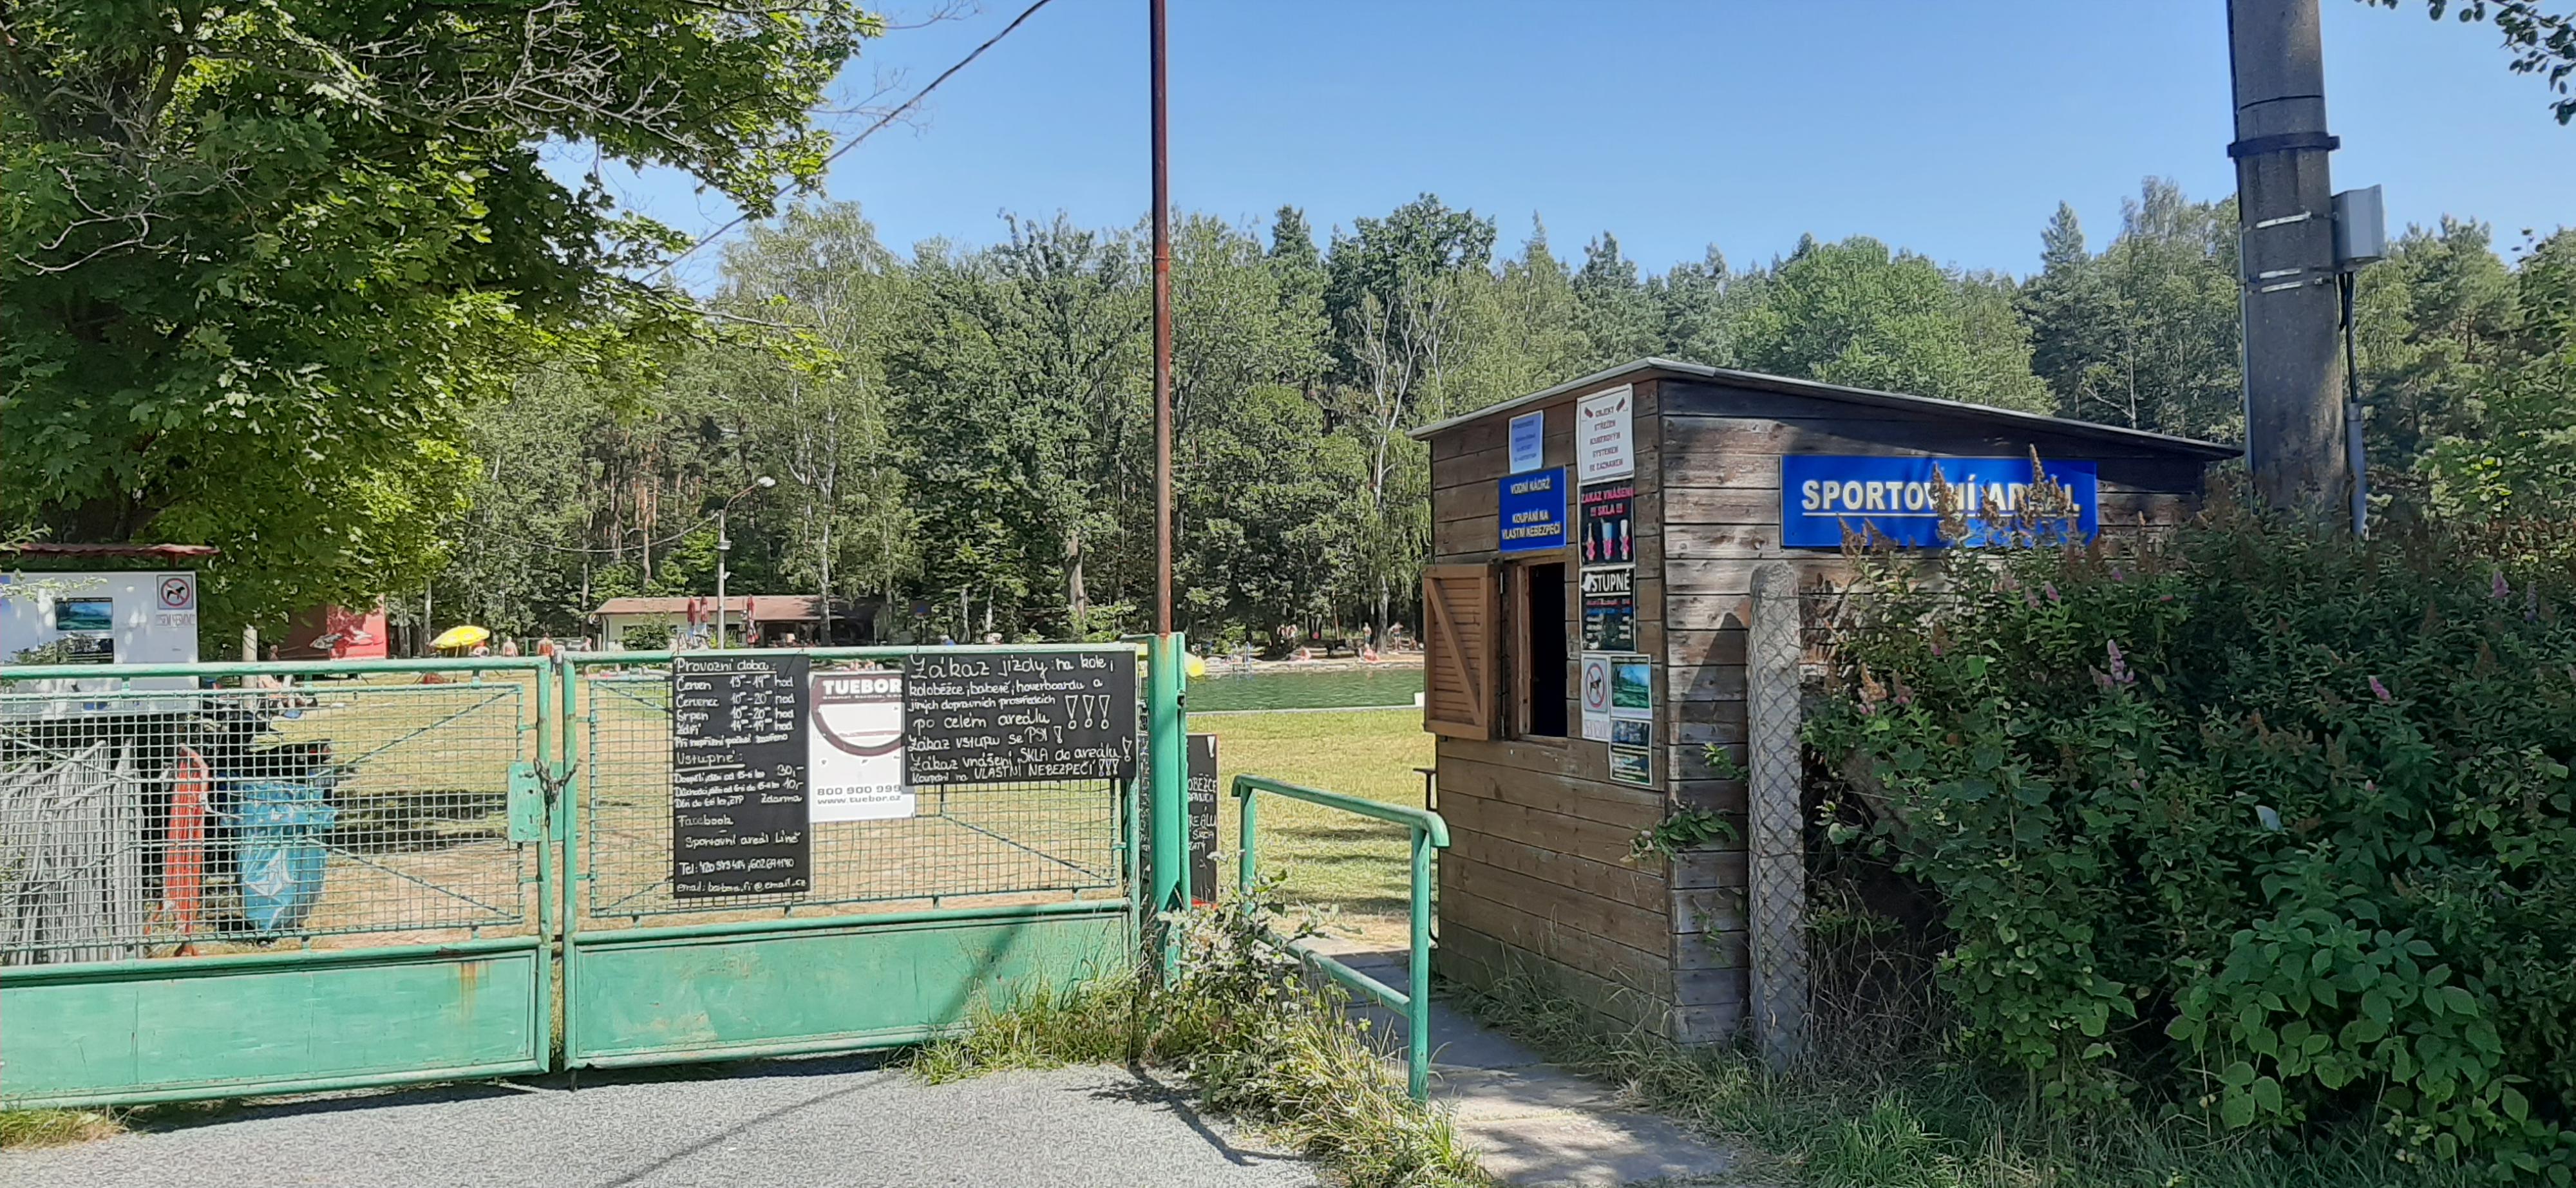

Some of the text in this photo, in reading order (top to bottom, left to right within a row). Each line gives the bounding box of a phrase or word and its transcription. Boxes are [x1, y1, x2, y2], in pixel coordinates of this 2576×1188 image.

[1510, 475, 1551, 495] VODNÍ NÁDRŽ
[1512, 508, 1549, 523] KOUPÁNÍ NA
[1501, 521, 1561, 540] VLASTNÍ NEBEZPEČÍ
[1585, 568, 1631, 592] STUPNÉ
[674, 657, 734, 672] Provozní
[909, 654, 990, 679] Zákaz
[998, 654, 1048, 679] jízdy
[1055, 657, 1075, 672] na
[676, 675, 712, 692] Červen
[822, 678, 902, 695] TUEBOR
[1093, 678, 1103, 688] a
[676, 693, 720, 708] Červenec
[676, 709, 709, 722] Srpen
[913, 707, 1050, 736] po celém areálu
[907, 733, 951, 752] Zákaz
[955, 736, 1000, 750] vstupu
[1008, 733, 1024, 745] se
[909, 752, 959, 772] Zákaz
[1018, 747, 1048, 764] SKLA
[1055, 748, 1070, 761] do
[955, 773, 969, 782] na
[1028, 759, 1096, 777] NEBEZPEČÍ
[817, 784, 902, 796] 800 900 999
[817, 795, 902, 804] www.tuebor.cz
[676, 814, 734, 827] Facebook
[685, 834, 736, 849] Sportovní
[741, 832, 769, 845] areál
